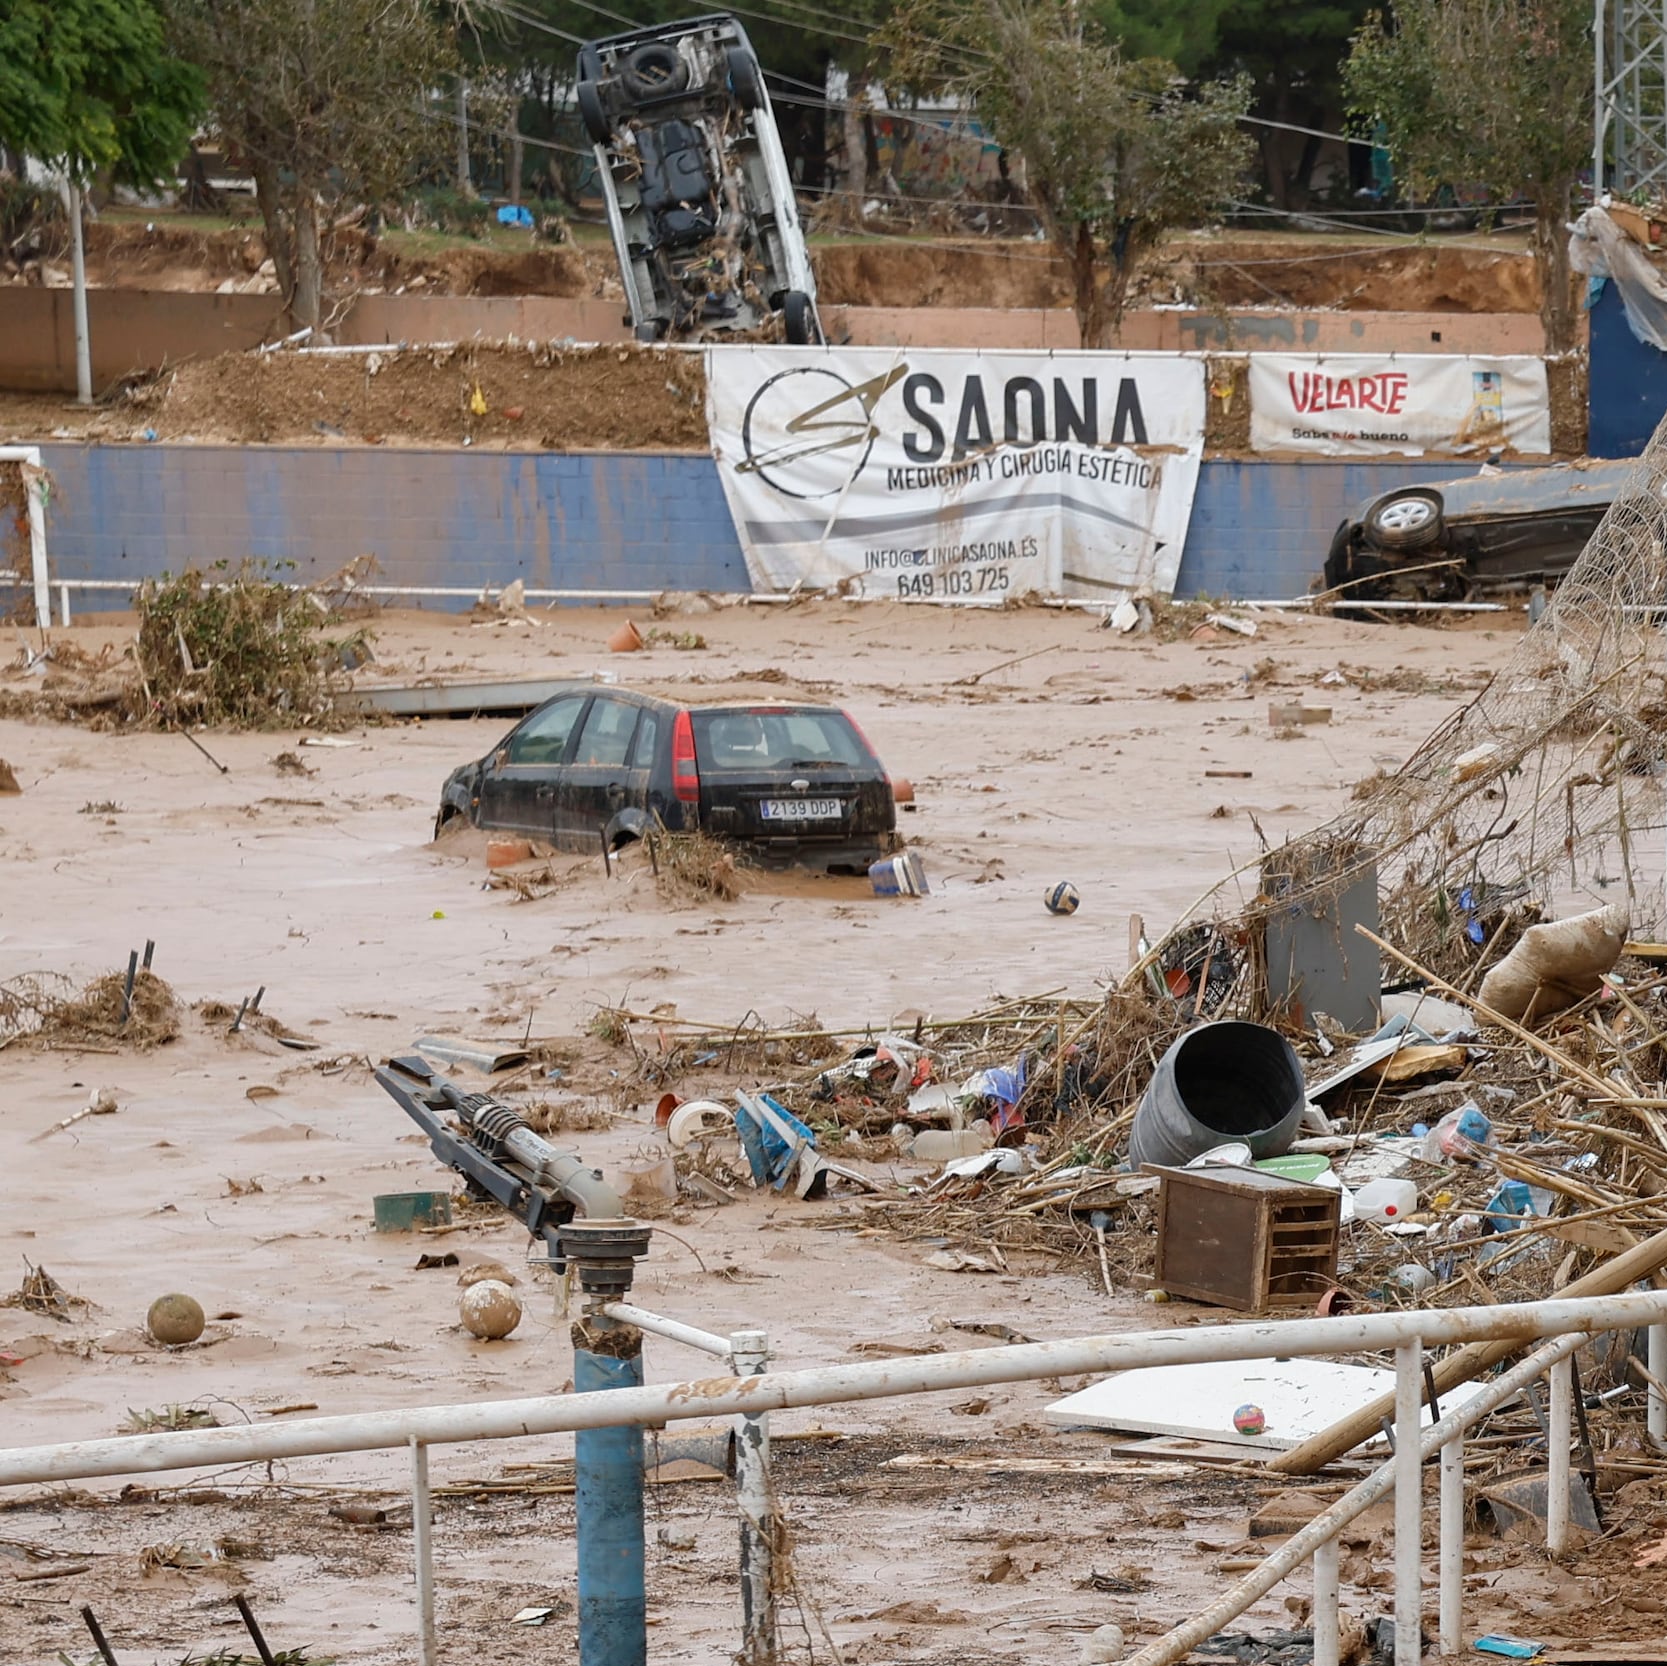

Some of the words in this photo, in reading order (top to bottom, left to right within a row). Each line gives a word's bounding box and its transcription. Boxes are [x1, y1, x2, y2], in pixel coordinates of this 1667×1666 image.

[1288, 371, 1408, 415] VELARTE
[902, 373, 1149, 463] SAONA
[1360, 430, 1409, 441] bueno
[887, 465, 980, 490] MEDICINA
[986, 457, 998, 481] Y
[1001, 448, 1071, 479] CIRUGÍA
[1078, 455, 1162, 489] ESTÉTICA
[897, 572, 934, 597] 649
[938, 569, 972, 595] 103
[976, 567, 1010, 592] 725
[771, 800, 807, 816] 2139
[810, 800, 837, 816] DDP
